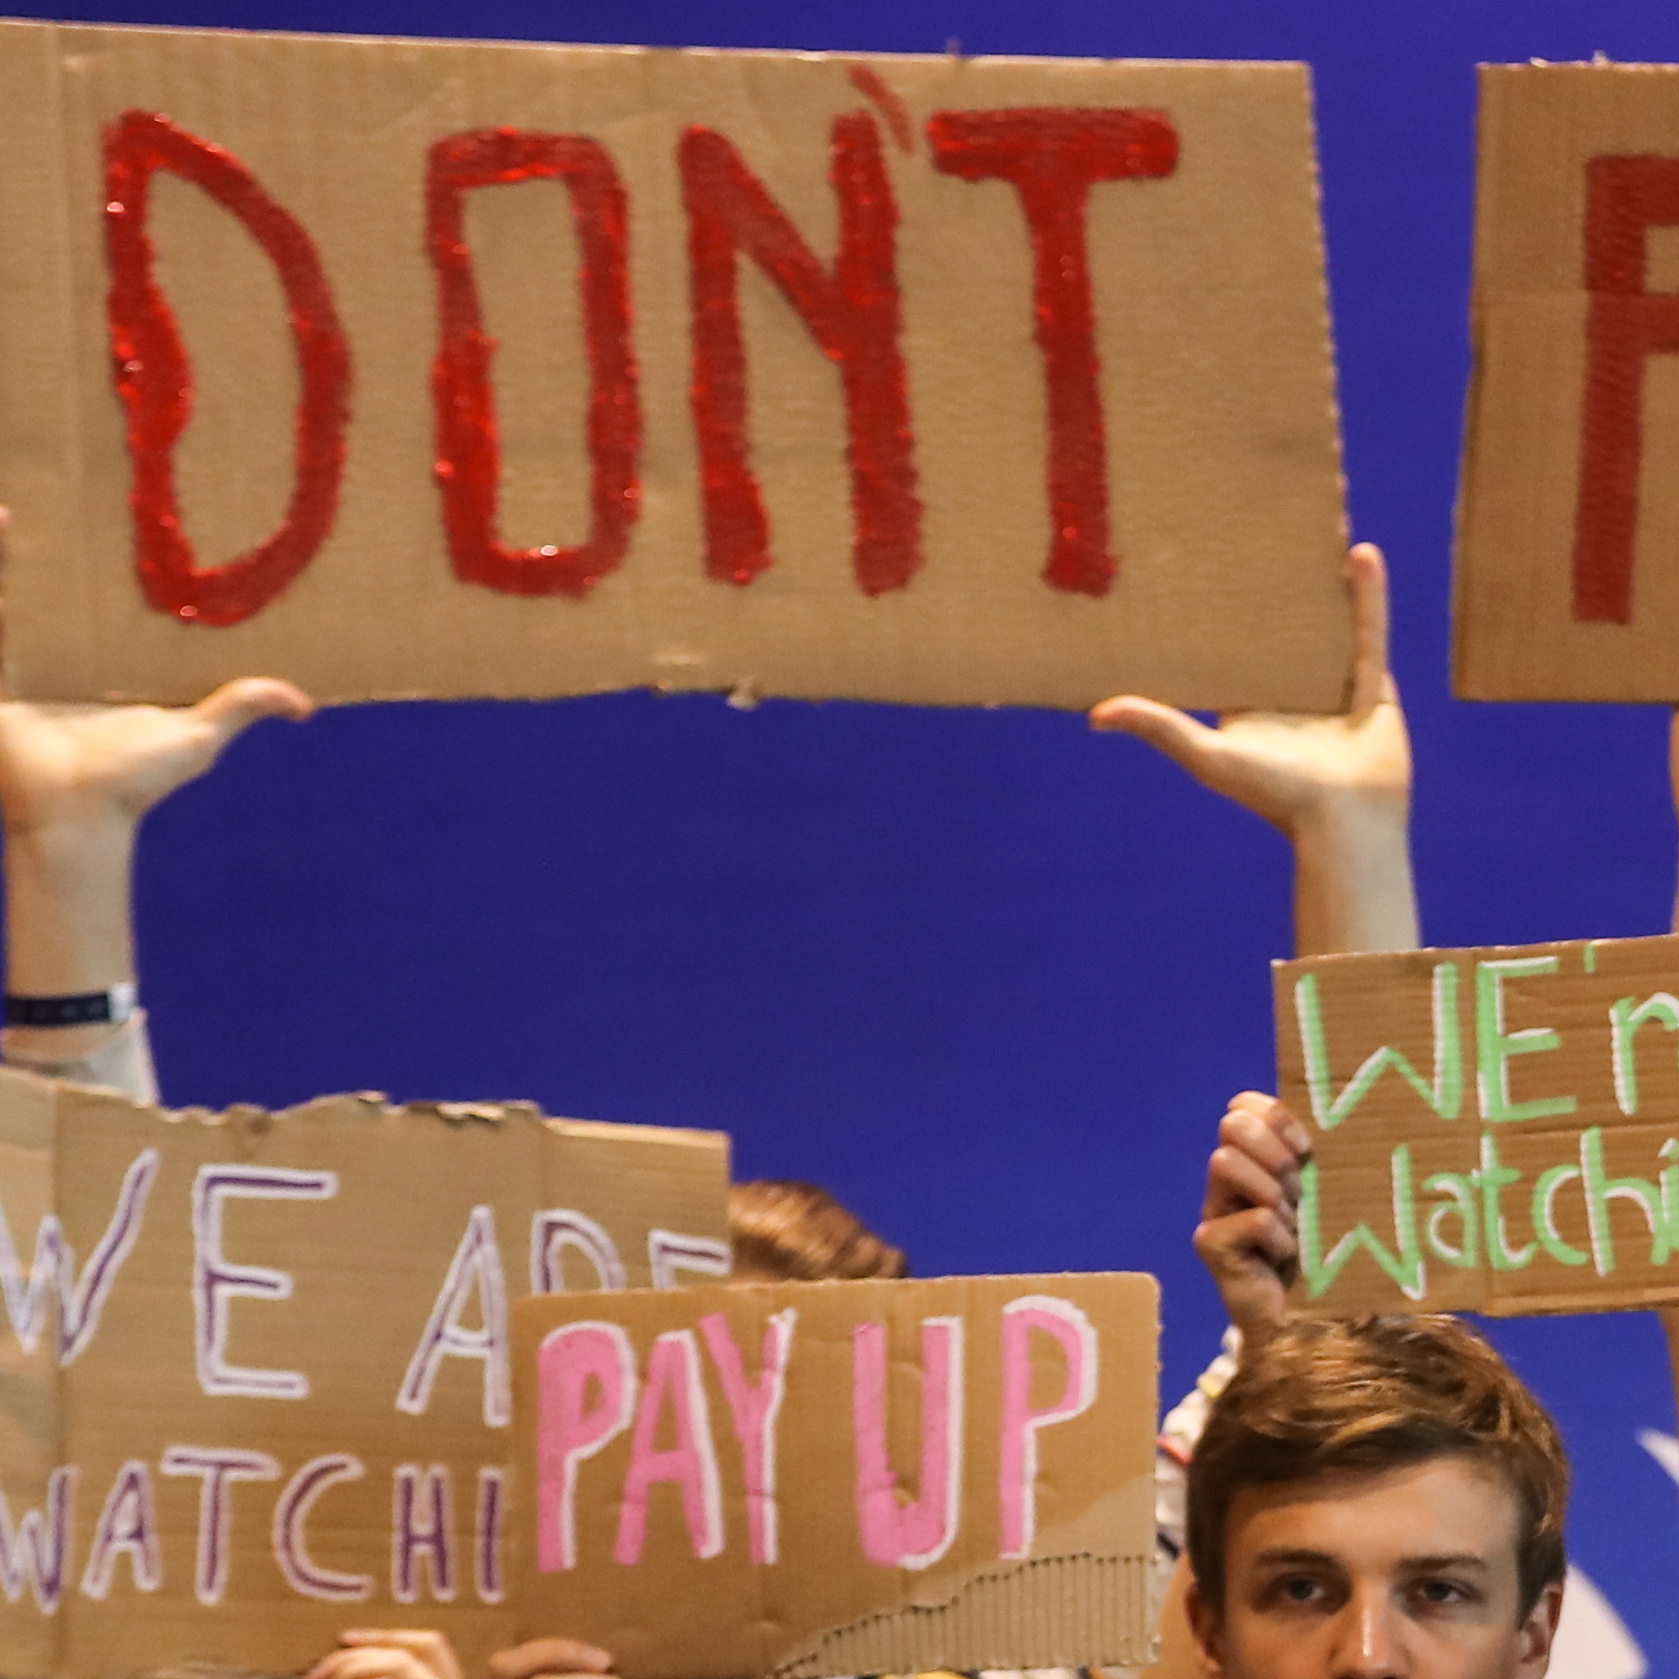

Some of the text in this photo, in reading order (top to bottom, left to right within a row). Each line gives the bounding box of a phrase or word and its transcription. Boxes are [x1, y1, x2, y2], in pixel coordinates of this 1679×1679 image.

[101, 65, 1179, 629] DON'T
[0, 1148, 336, 1399] WE
[0, 1446, 506, 1617] WATCHI
[536, 1308, 797, 1572] PAY
[853, 1296, 1097, 1570] UP
